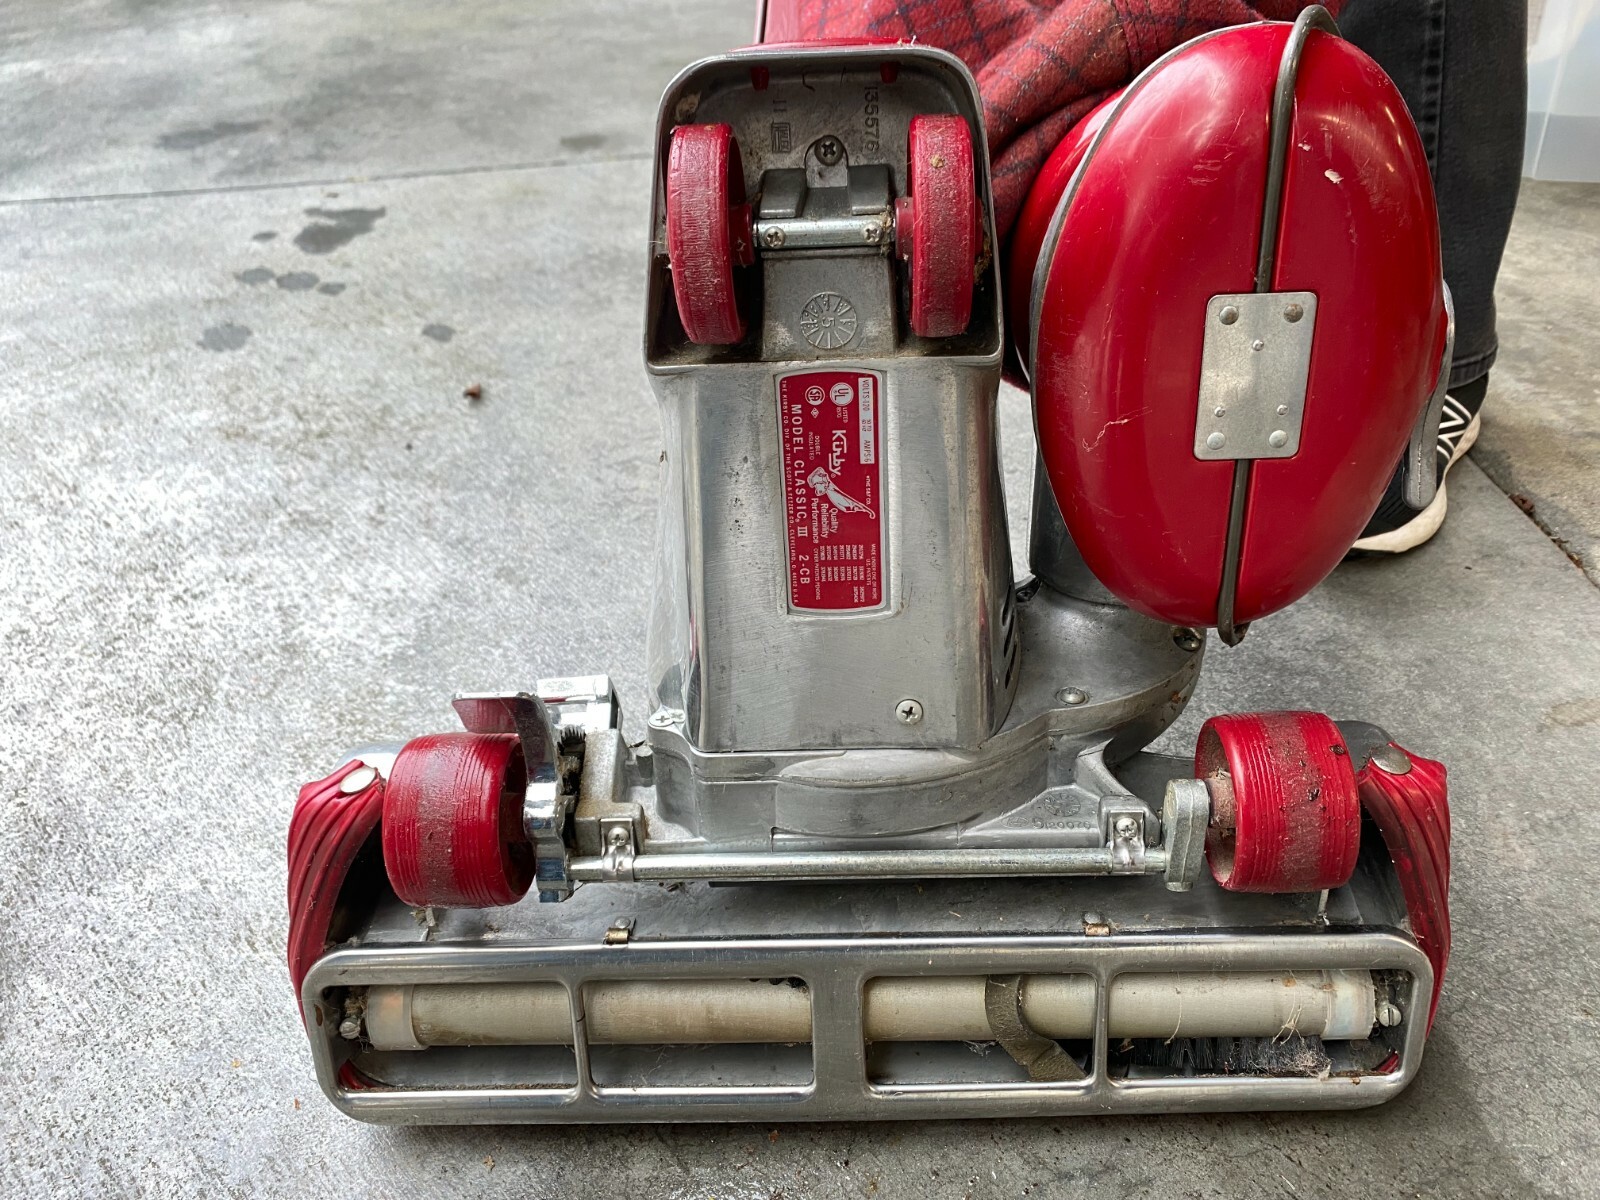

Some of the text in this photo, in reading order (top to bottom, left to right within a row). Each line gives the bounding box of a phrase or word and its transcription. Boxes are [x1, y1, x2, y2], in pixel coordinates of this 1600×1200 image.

[835, 388, 849, 400] UL
[829, 430, 846, 476] Kirby
[791, 404, 810, 584] MODEL CLASSIC III 2-CB
[811, 498, 819, 544] Performance
[820, 503, 829, 538] Reliability
[829, 508, 838, 533] Quality
